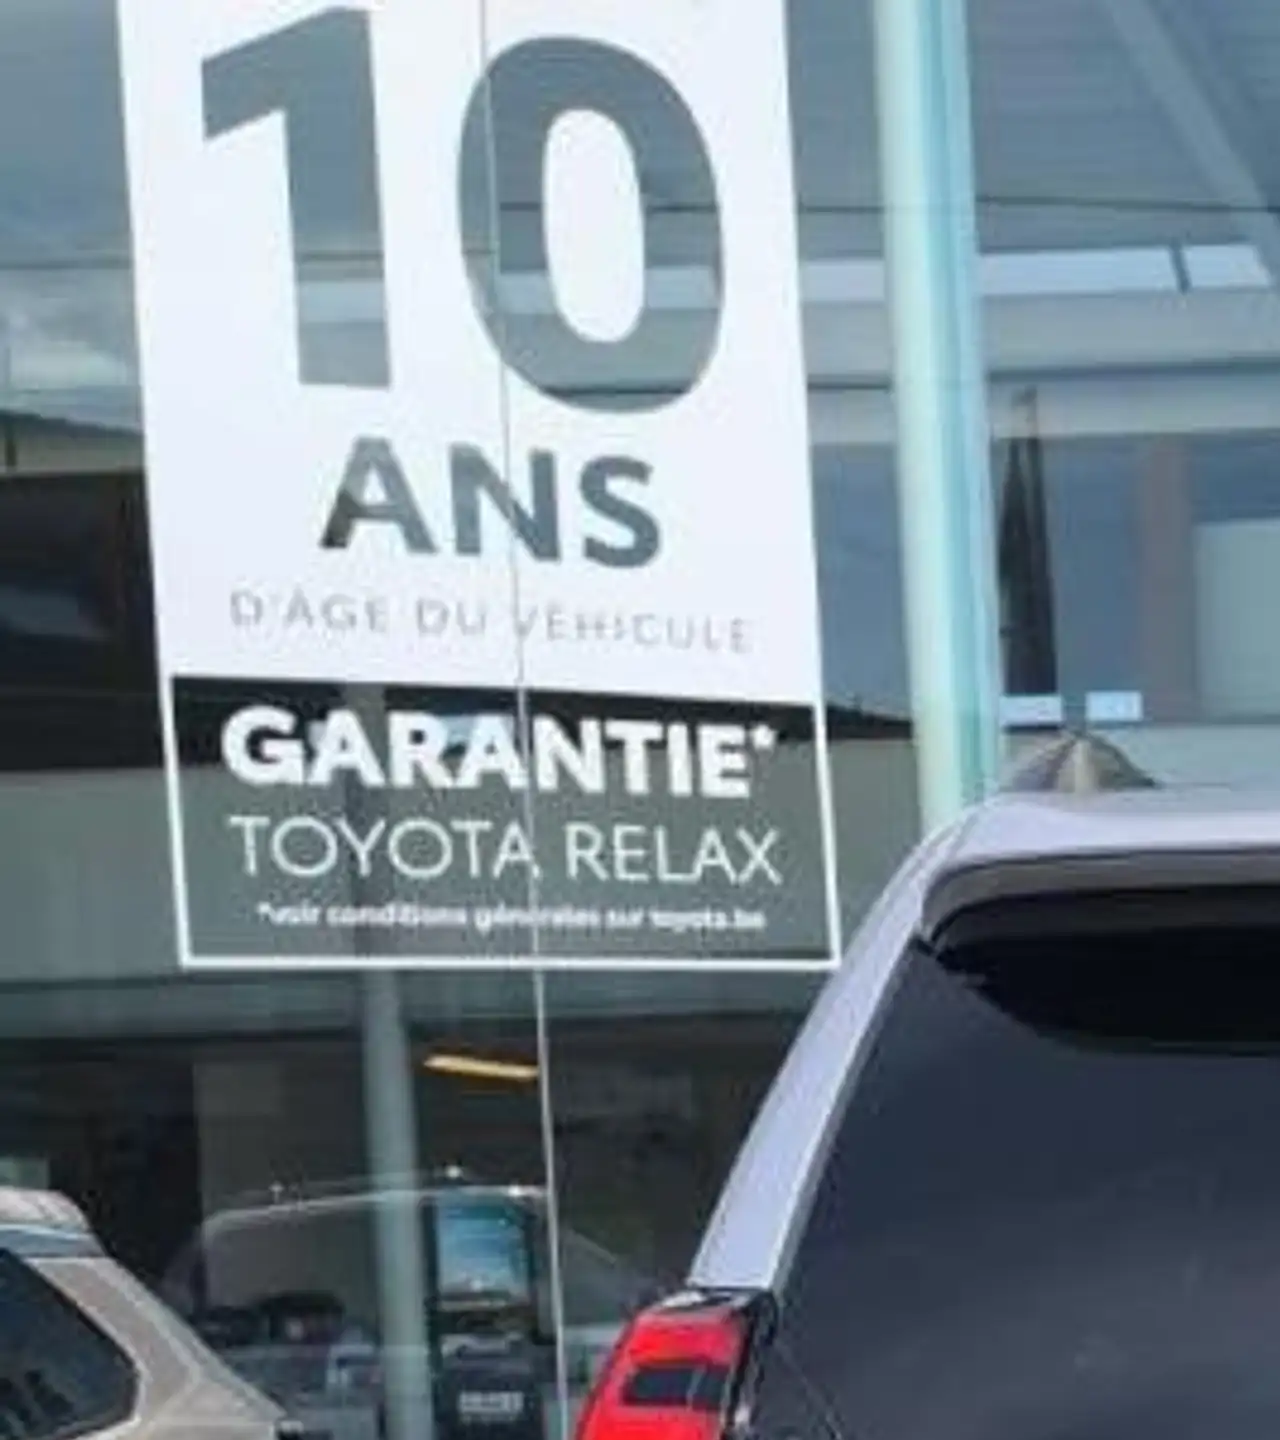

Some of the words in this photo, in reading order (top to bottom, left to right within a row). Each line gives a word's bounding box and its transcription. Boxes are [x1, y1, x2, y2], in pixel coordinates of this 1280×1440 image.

[201, 3, 726, 415] 10
[320, 436, 660, 567] ANS
[417, 597, 488, 637] DU
[228, 815, 541, 880] TOYOTA
[563, 821, 784, 885] RELAX
[325, 902, 467, 928] conditions
[606, 906, 644, 929] sur
